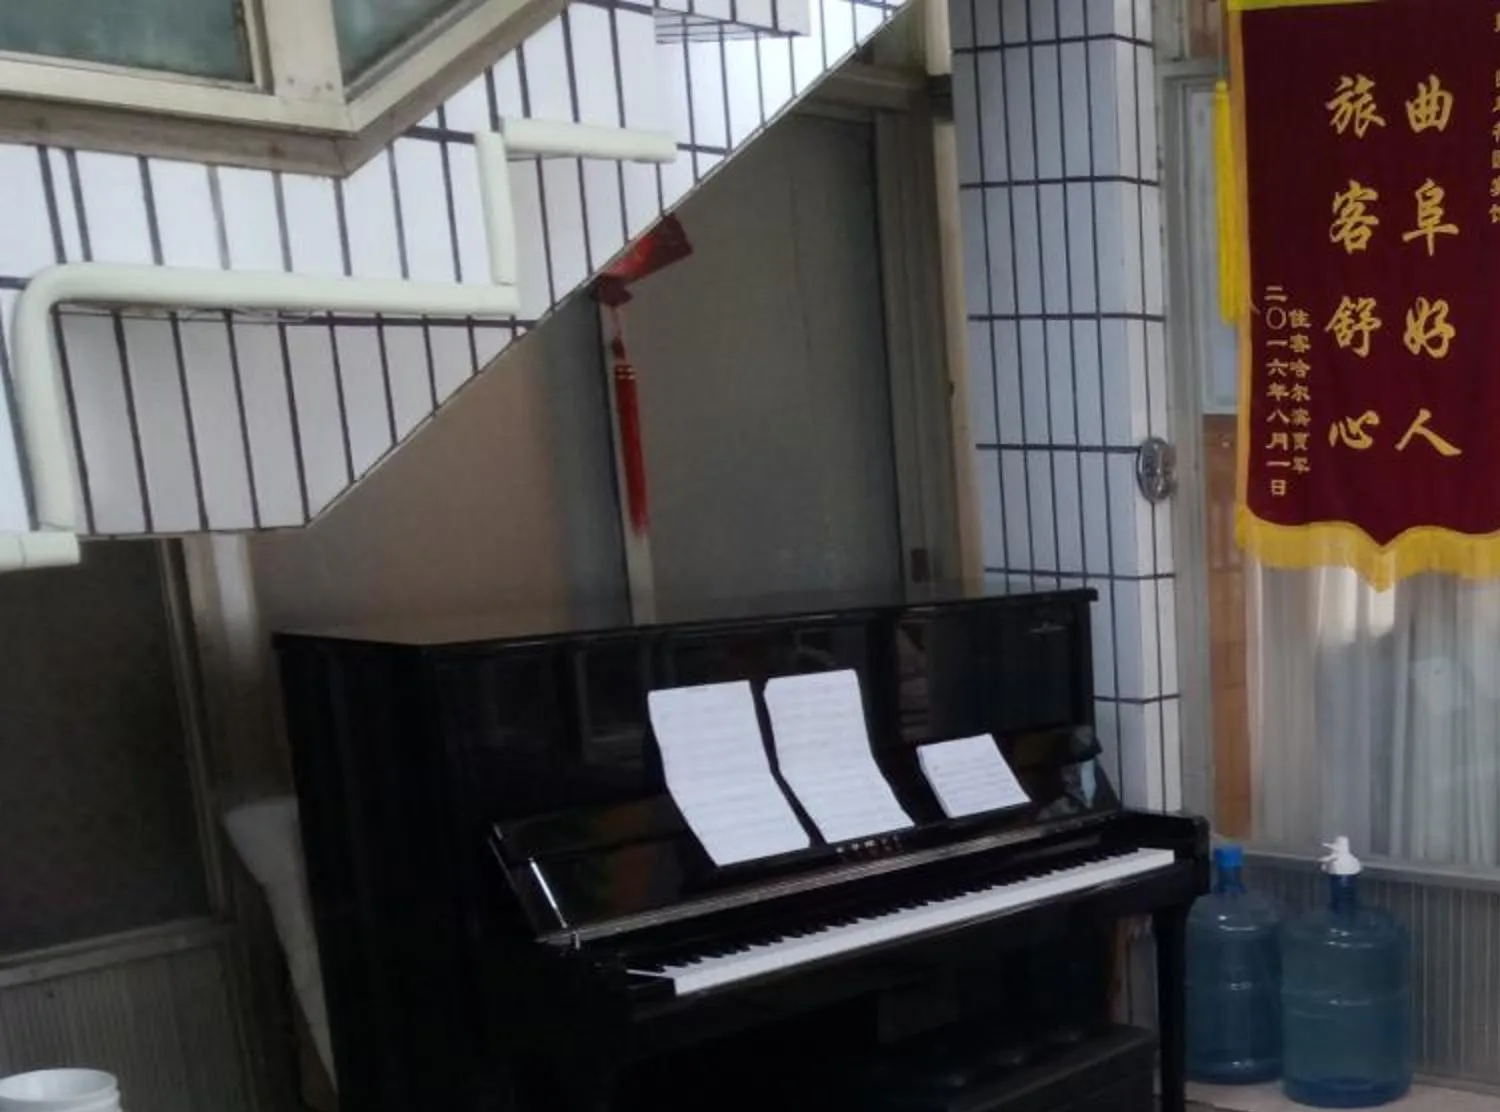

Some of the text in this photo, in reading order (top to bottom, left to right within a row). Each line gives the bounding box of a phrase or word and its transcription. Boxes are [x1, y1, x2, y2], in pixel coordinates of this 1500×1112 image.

[1324, 75, 1387, 452] 旅客舒心
[1395, 73, 1462, 457] 曲阜好人
